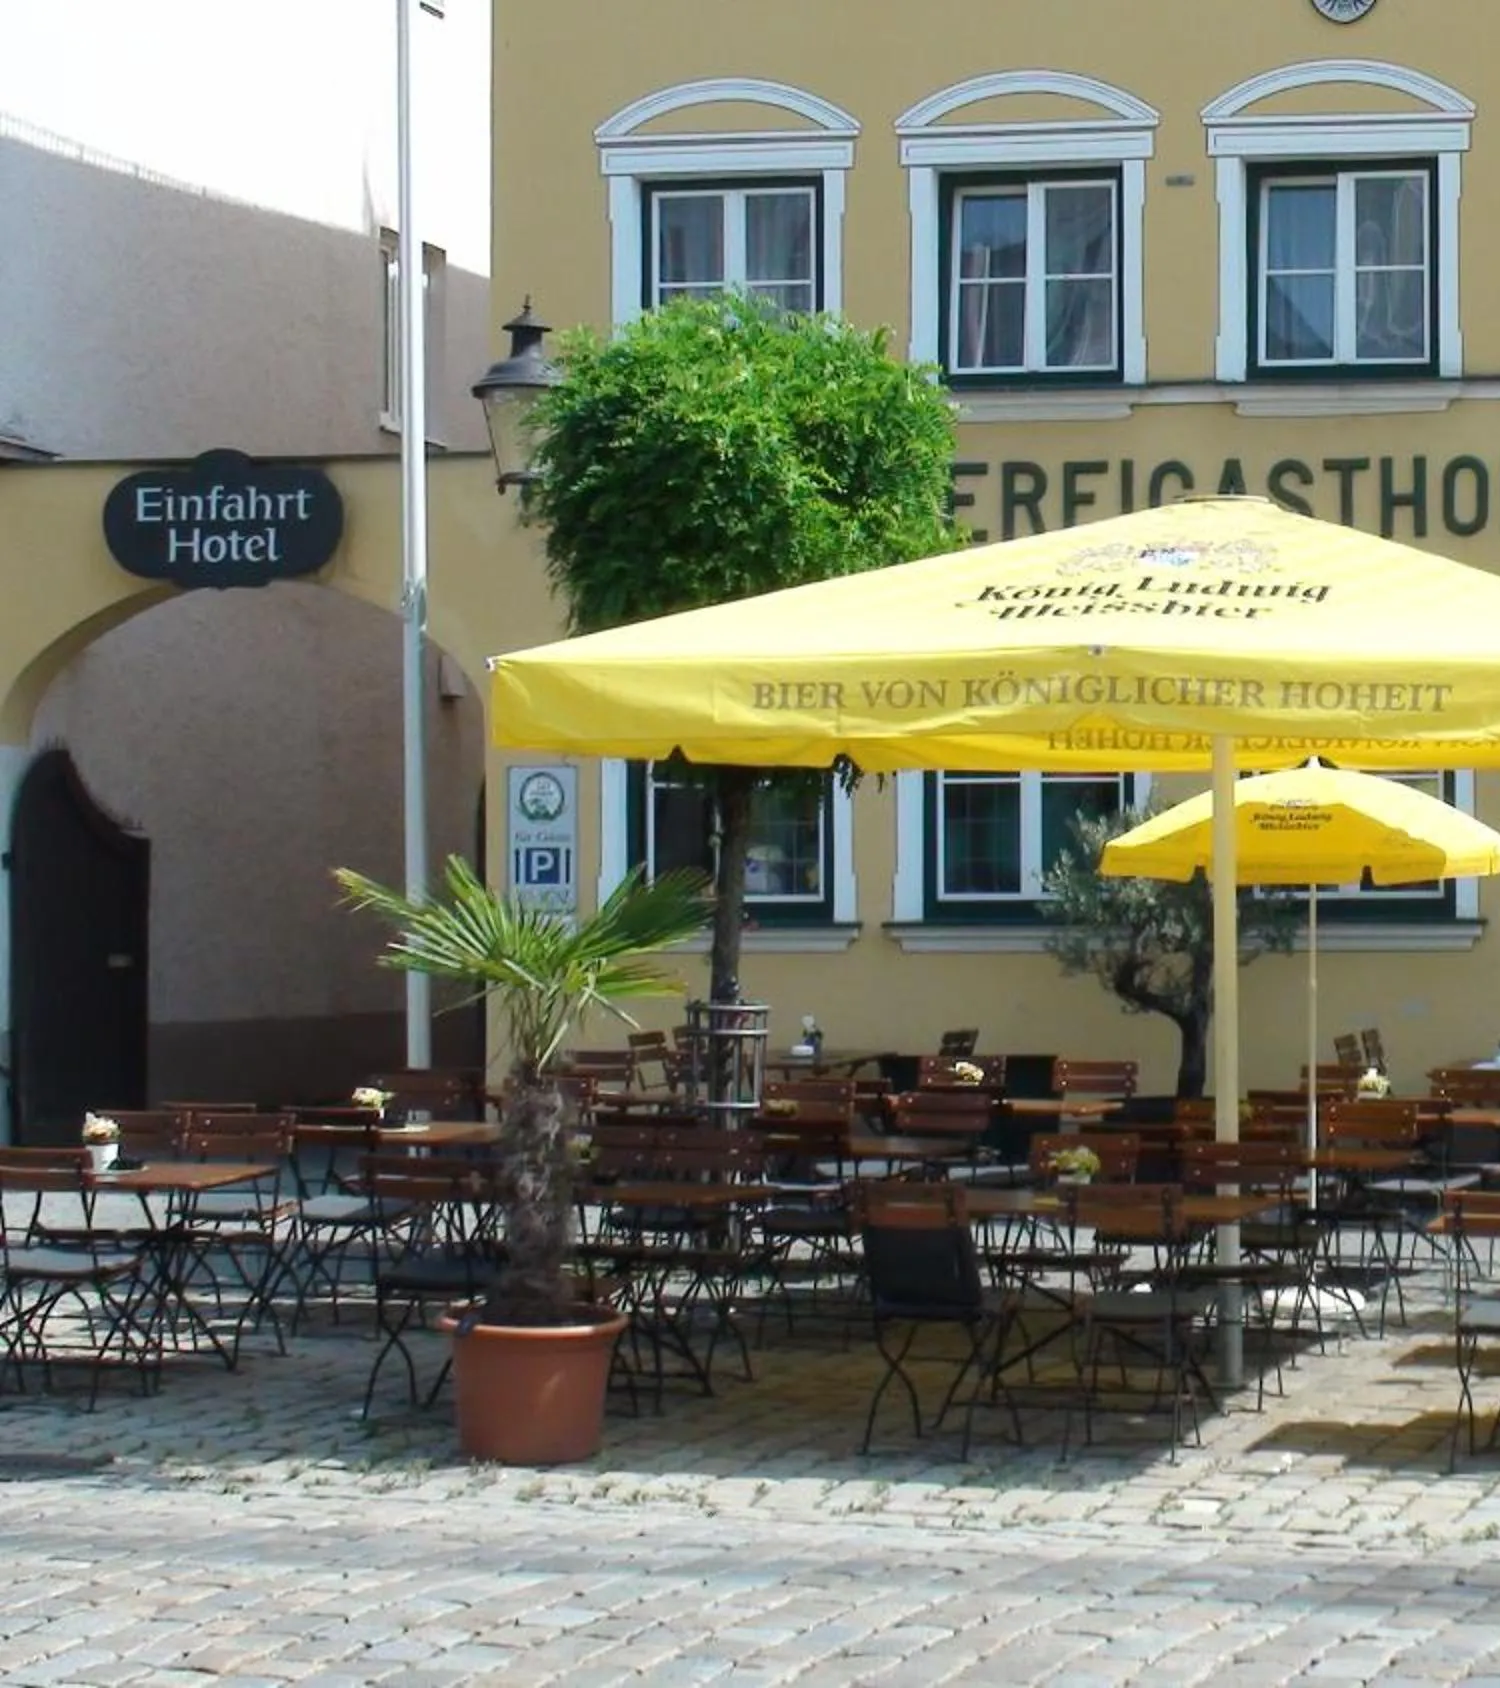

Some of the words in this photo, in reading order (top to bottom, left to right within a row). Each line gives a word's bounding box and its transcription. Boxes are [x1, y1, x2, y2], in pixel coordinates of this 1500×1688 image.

[135, 485, 313, 522] Einfahrt
[167, 527, 281, 563] Hotel
[977, 580, 1125, 601] König
[1136, 576, 1332, 603] Ludwig
[752, 681, 848, 710] BIER
[861, 678, 948, 709] VON
[961, 670, 1266, 708] KÖNIGLICHER
[1279, 680, 1453, 712] HOHEIT
[531, 850, 555, 881] P
